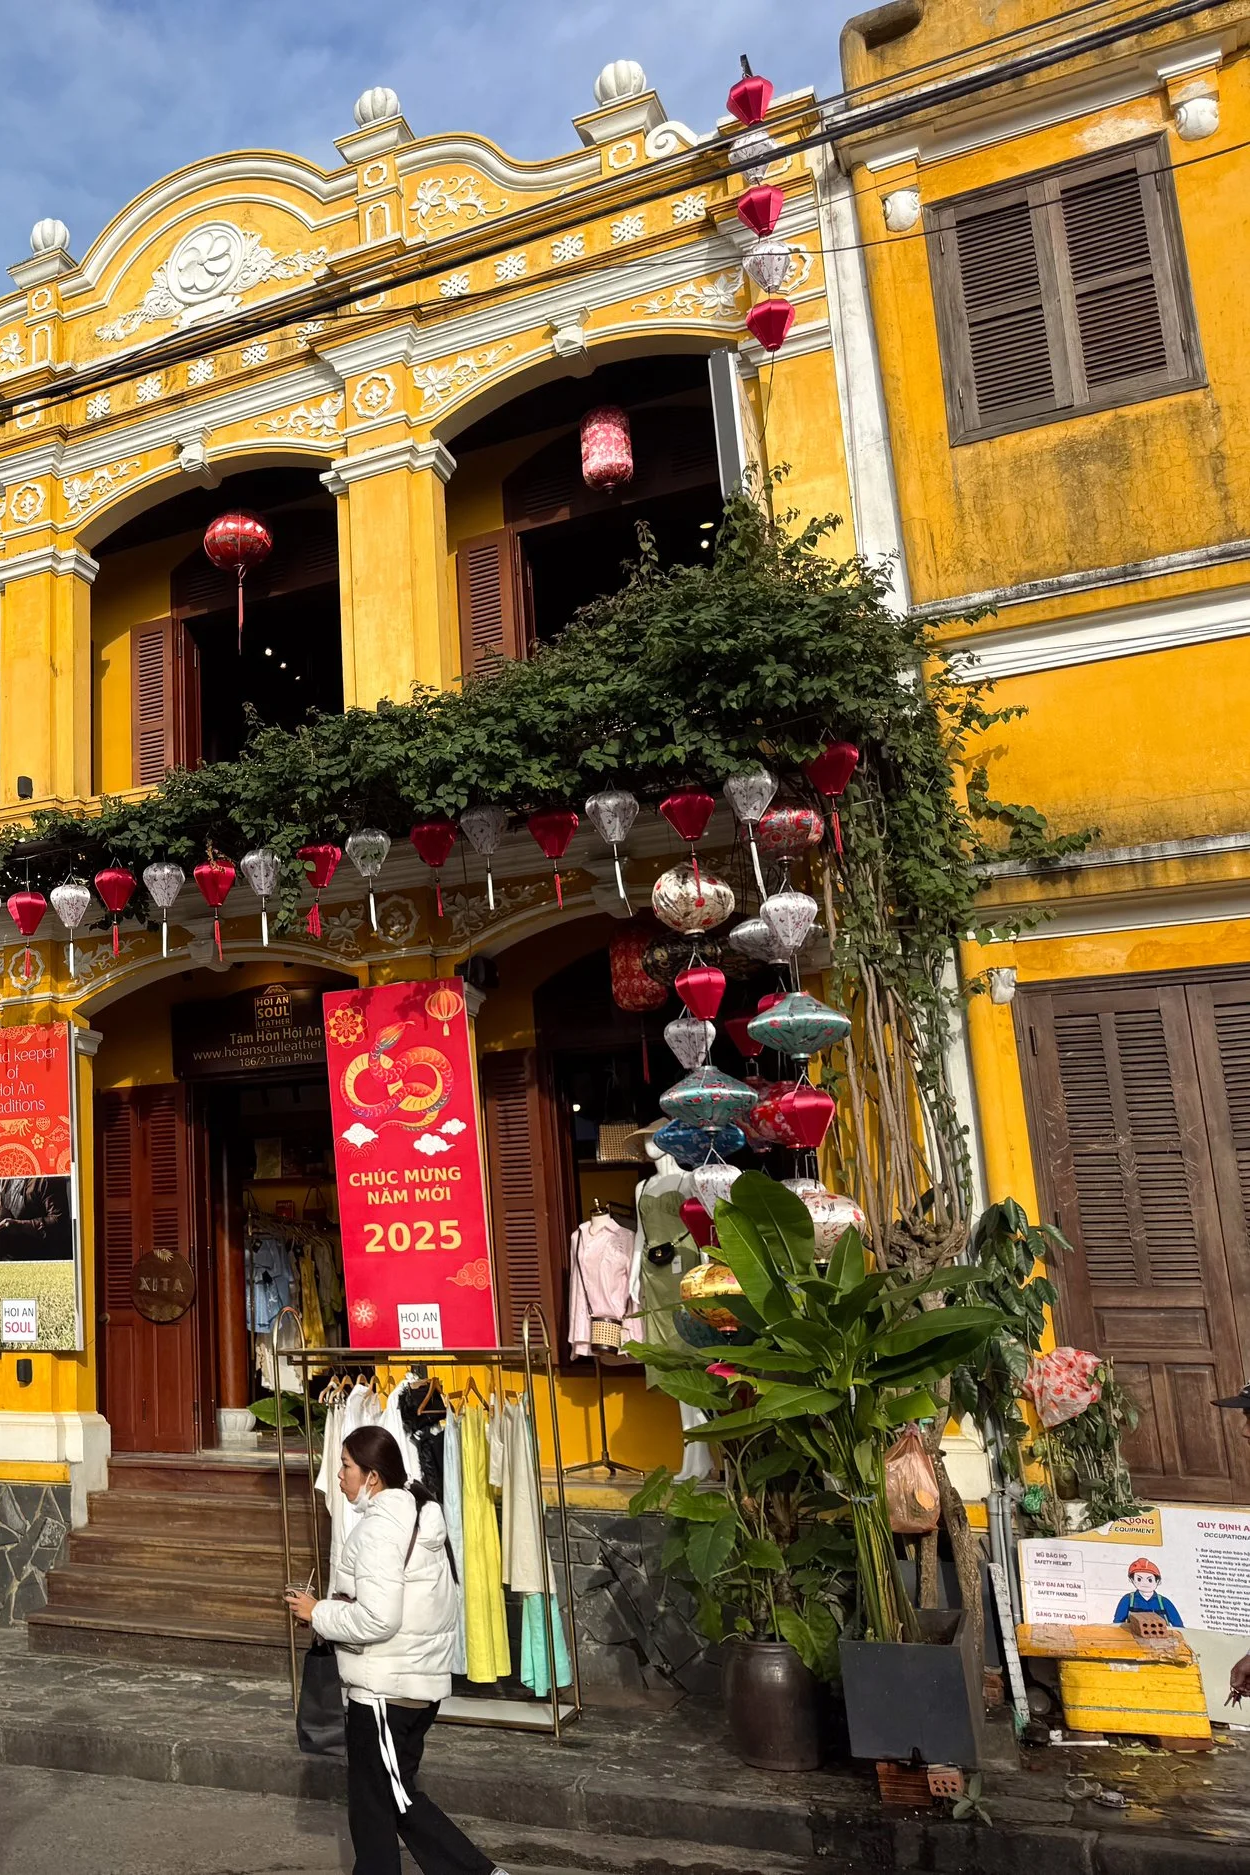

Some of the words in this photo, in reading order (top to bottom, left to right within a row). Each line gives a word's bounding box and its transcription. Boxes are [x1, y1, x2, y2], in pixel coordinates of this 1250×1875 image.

[256, 998, 273, 1007] HOI
[275, 996, 289, 1005] AN
[257, 1006, 290, 1019] SOUL
[257, 1019, 291, 1028] LEATHER
[230, 1032, 253, 1045] Tâm
[282, 1027, 302, 1041] Hội
[305, 1026, 321, 1036] An
[14, 1047, 59, 1063] keeper
[240, 1056, 266, 1067] 186/2
[7, 1064, 19, 1080] of
[18, 1081, 35, 1095] An
[349, 1168, 399, 1187] CHÚC
[404, 1165, 462, 1184] MỪNG
[367, 1187, 408, 1205] NĂM
[415, 1185, 451, 1202] MỚI
[363, 1219, 462, 1253] 2025
[138, 1276, 184, 1293] XITA
[4, 1308, 19, 1317] HOI
[22, 1307, 34, 1317] AN
[400, 1312, 420, 1323] HOI
[422, 1312, 438, 1322] AN
[4, 1321, 34, 1333] SOUL
[402, 1328, 439, 1340] SOUL
[1114, 1526, 1155, 1534] EQUIPMENT
[1197, 1521, 1216, 1529] QUY
[1218, 1523, 1241, 1531] ĐỊNH
